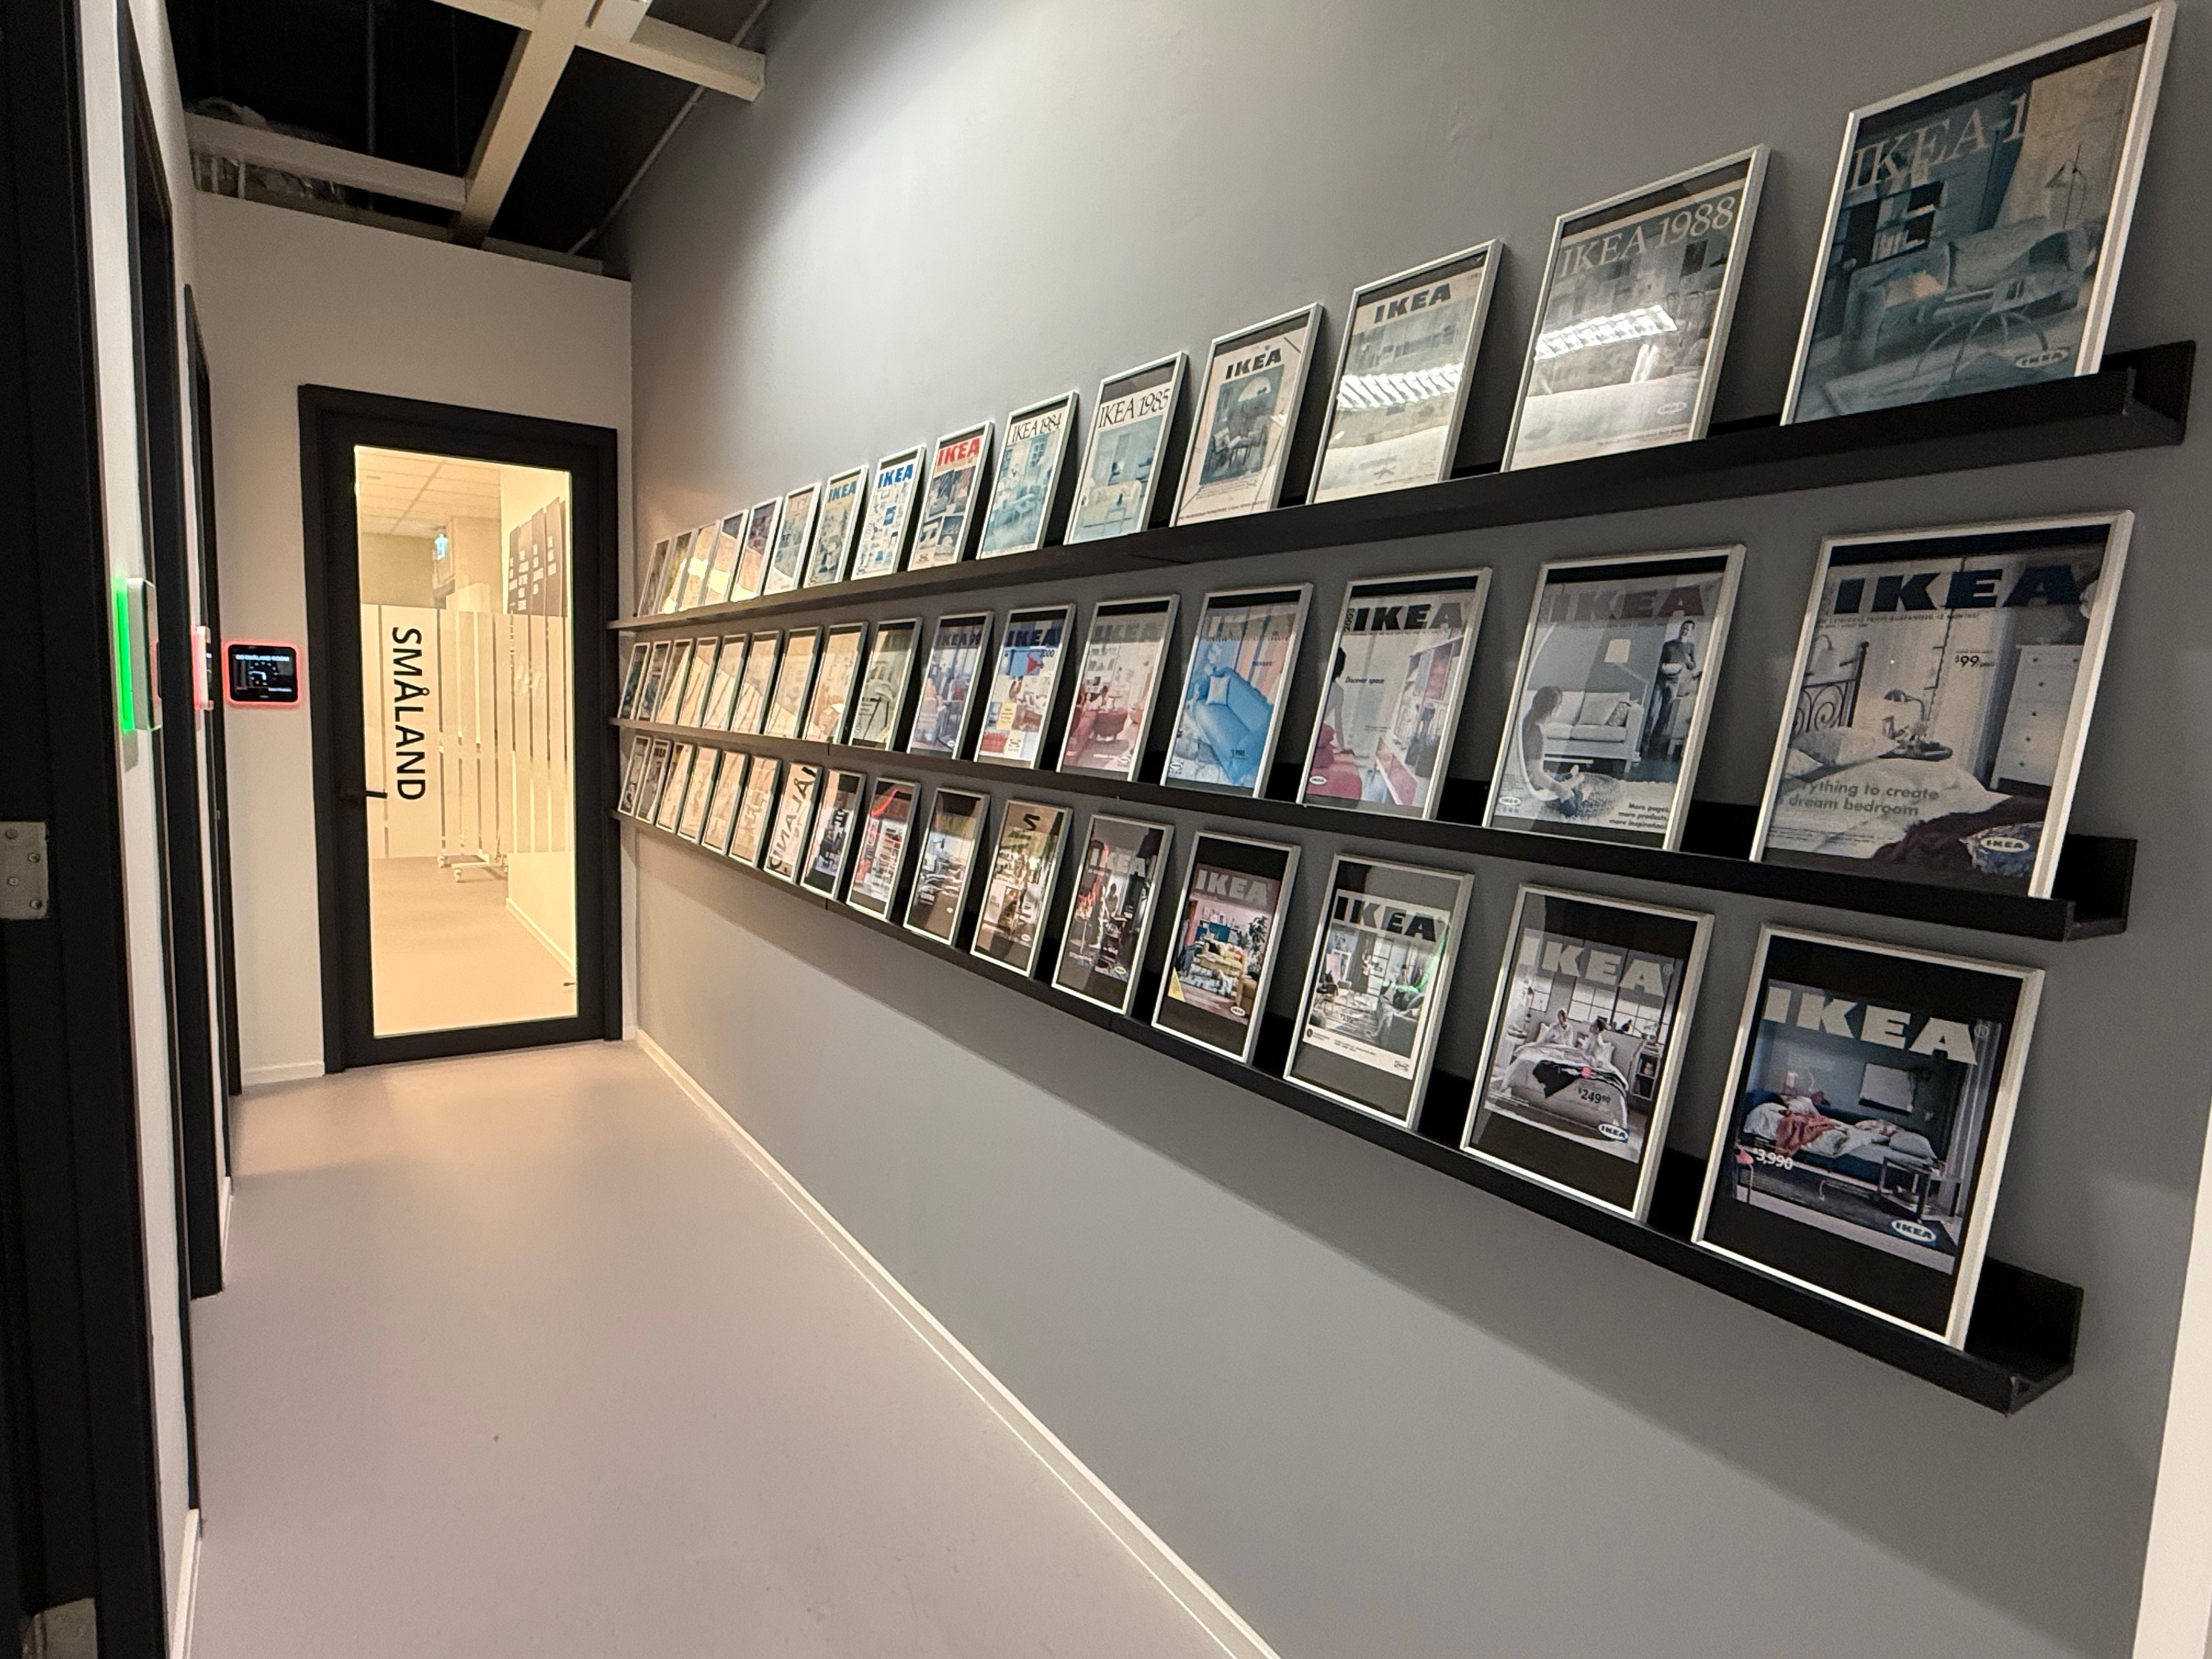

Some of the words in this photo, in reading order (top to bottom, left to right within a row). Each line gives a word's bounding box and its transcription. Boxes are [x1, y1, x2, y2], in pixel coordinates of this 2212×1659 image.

[1850, 108, 1988, 192] IKEA
[1561, 225, 1646, 278] IKEA
[1656, 196, 1736, 249] 1988
[1374, 283, 1451, 324] IKEA
[1225, 347, 1282, 380] IKEA
[1098, 397, 1135, 427] IKEA
[1137, 388, 1171, 417] 1985
[1012, 419, 1038, 443] IKEA
[937, 438, 979, 467] IKEA
[828, 480, 857, 502] IKEA
[878, 464, 914, 489] IKEA
[1549, 584, 1705, 622] IKEA
[1833, 564, 2082, 615] IKEA
[1353, 603, 1462, 631] IKEA
[1006, 628, 1059, 647] IKEA
[392, 626, 430, 801] SMÅLAND
[1788, 793, 1838, 810] dream
[1843, 797, 1919, 816] bedroom
[1863, 783, 1881, 796] to
[1886, 786, 1940, 801] create
[1986, 839, 2024, 849] IKEA
[1195, 869, 1268, 906] IKEA
[1334, 895, 1436, 943] IKEA
[1518, 936, 1665, 999] IKEA
[1763, 986, 1978, 1065] IKEA
[1601, 1125, 1626, 1138] IKEA
[1896, 1222, 1932, 1239] IKEA
